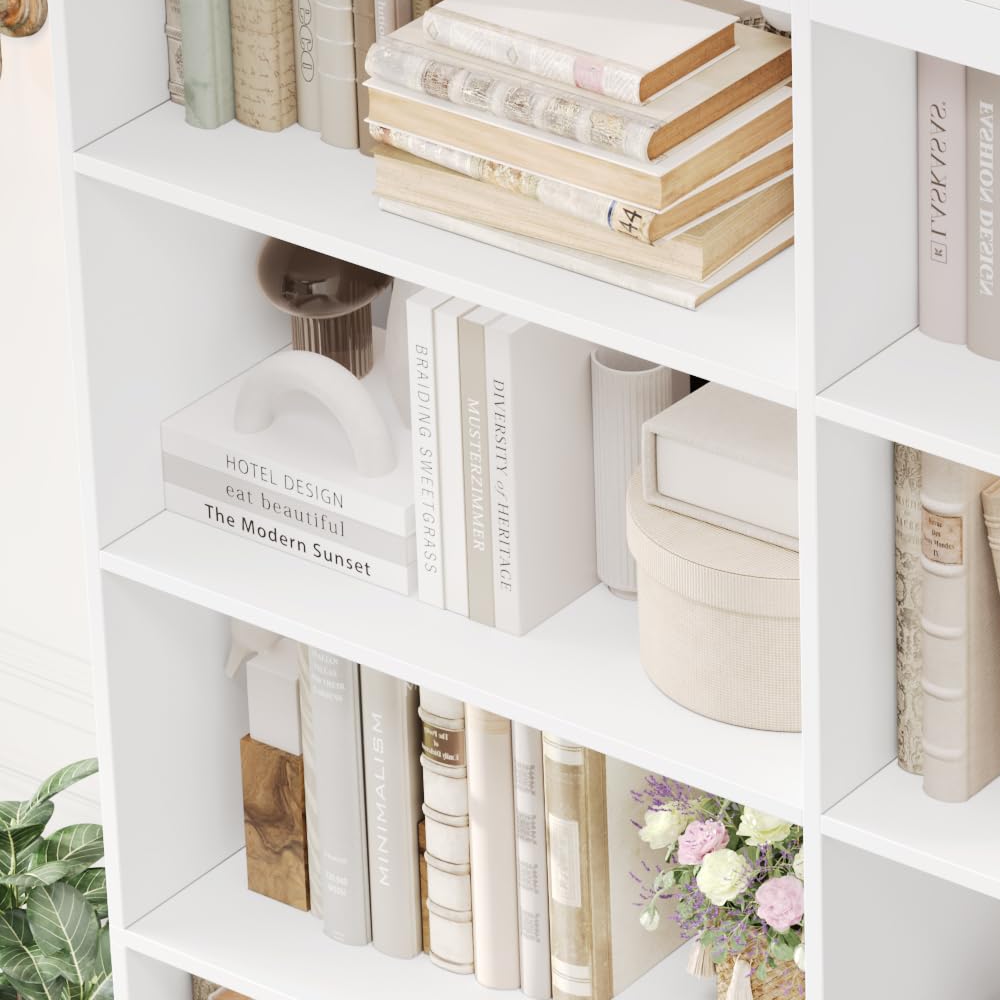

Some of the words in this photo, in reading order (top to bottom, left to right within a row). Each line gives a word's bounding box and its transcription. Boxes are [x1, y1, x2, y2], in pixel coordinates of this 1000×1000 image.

[416, 344, 432, 439] BRAIDING
[493, 378, 508, 477] DIVERSITY
[226, 454, 278, 486] HOTEL
[284, 474, 344, 509] DESIGN
[226, 485, 253, 504] eat
[261, 493, 344, 536] beautiful
[420, 447, 437, 574] SWEETGRASS
[467, 397, 485, 552] MUSTERZIMMER
[496, 480, 508, 499] of
[204, 504, 235, 527] The
[242, 517, 306, 553] Modern
[313, 543, 371, 576] Sunset
[498, 503, 512, 592] HERITAGE
[370, 711, 390, 887] MINIMALISM
